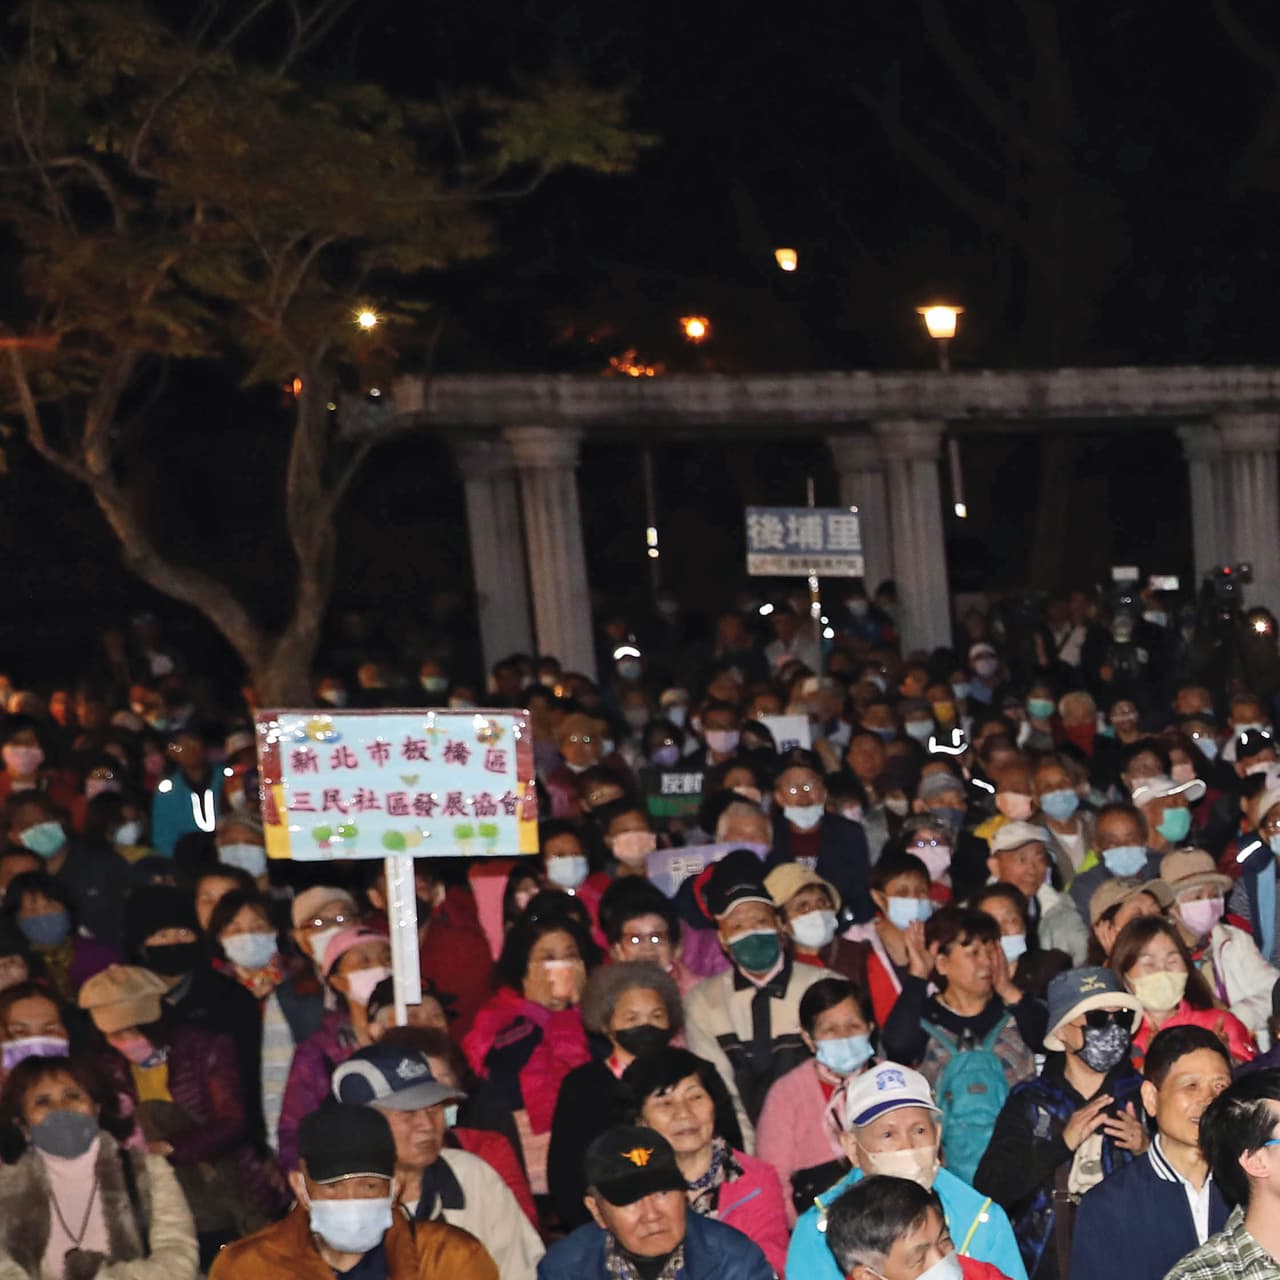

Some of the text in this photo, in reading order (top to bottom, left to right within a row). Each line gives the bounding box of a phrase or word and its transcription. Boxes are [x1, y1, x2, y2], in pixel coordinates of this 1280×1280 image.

[747, 514, 862, 550] 後埔里
[290, 736, 508, 775] 新北市板橋區
[289, 787, 519, 818] 三民社區發展協會
